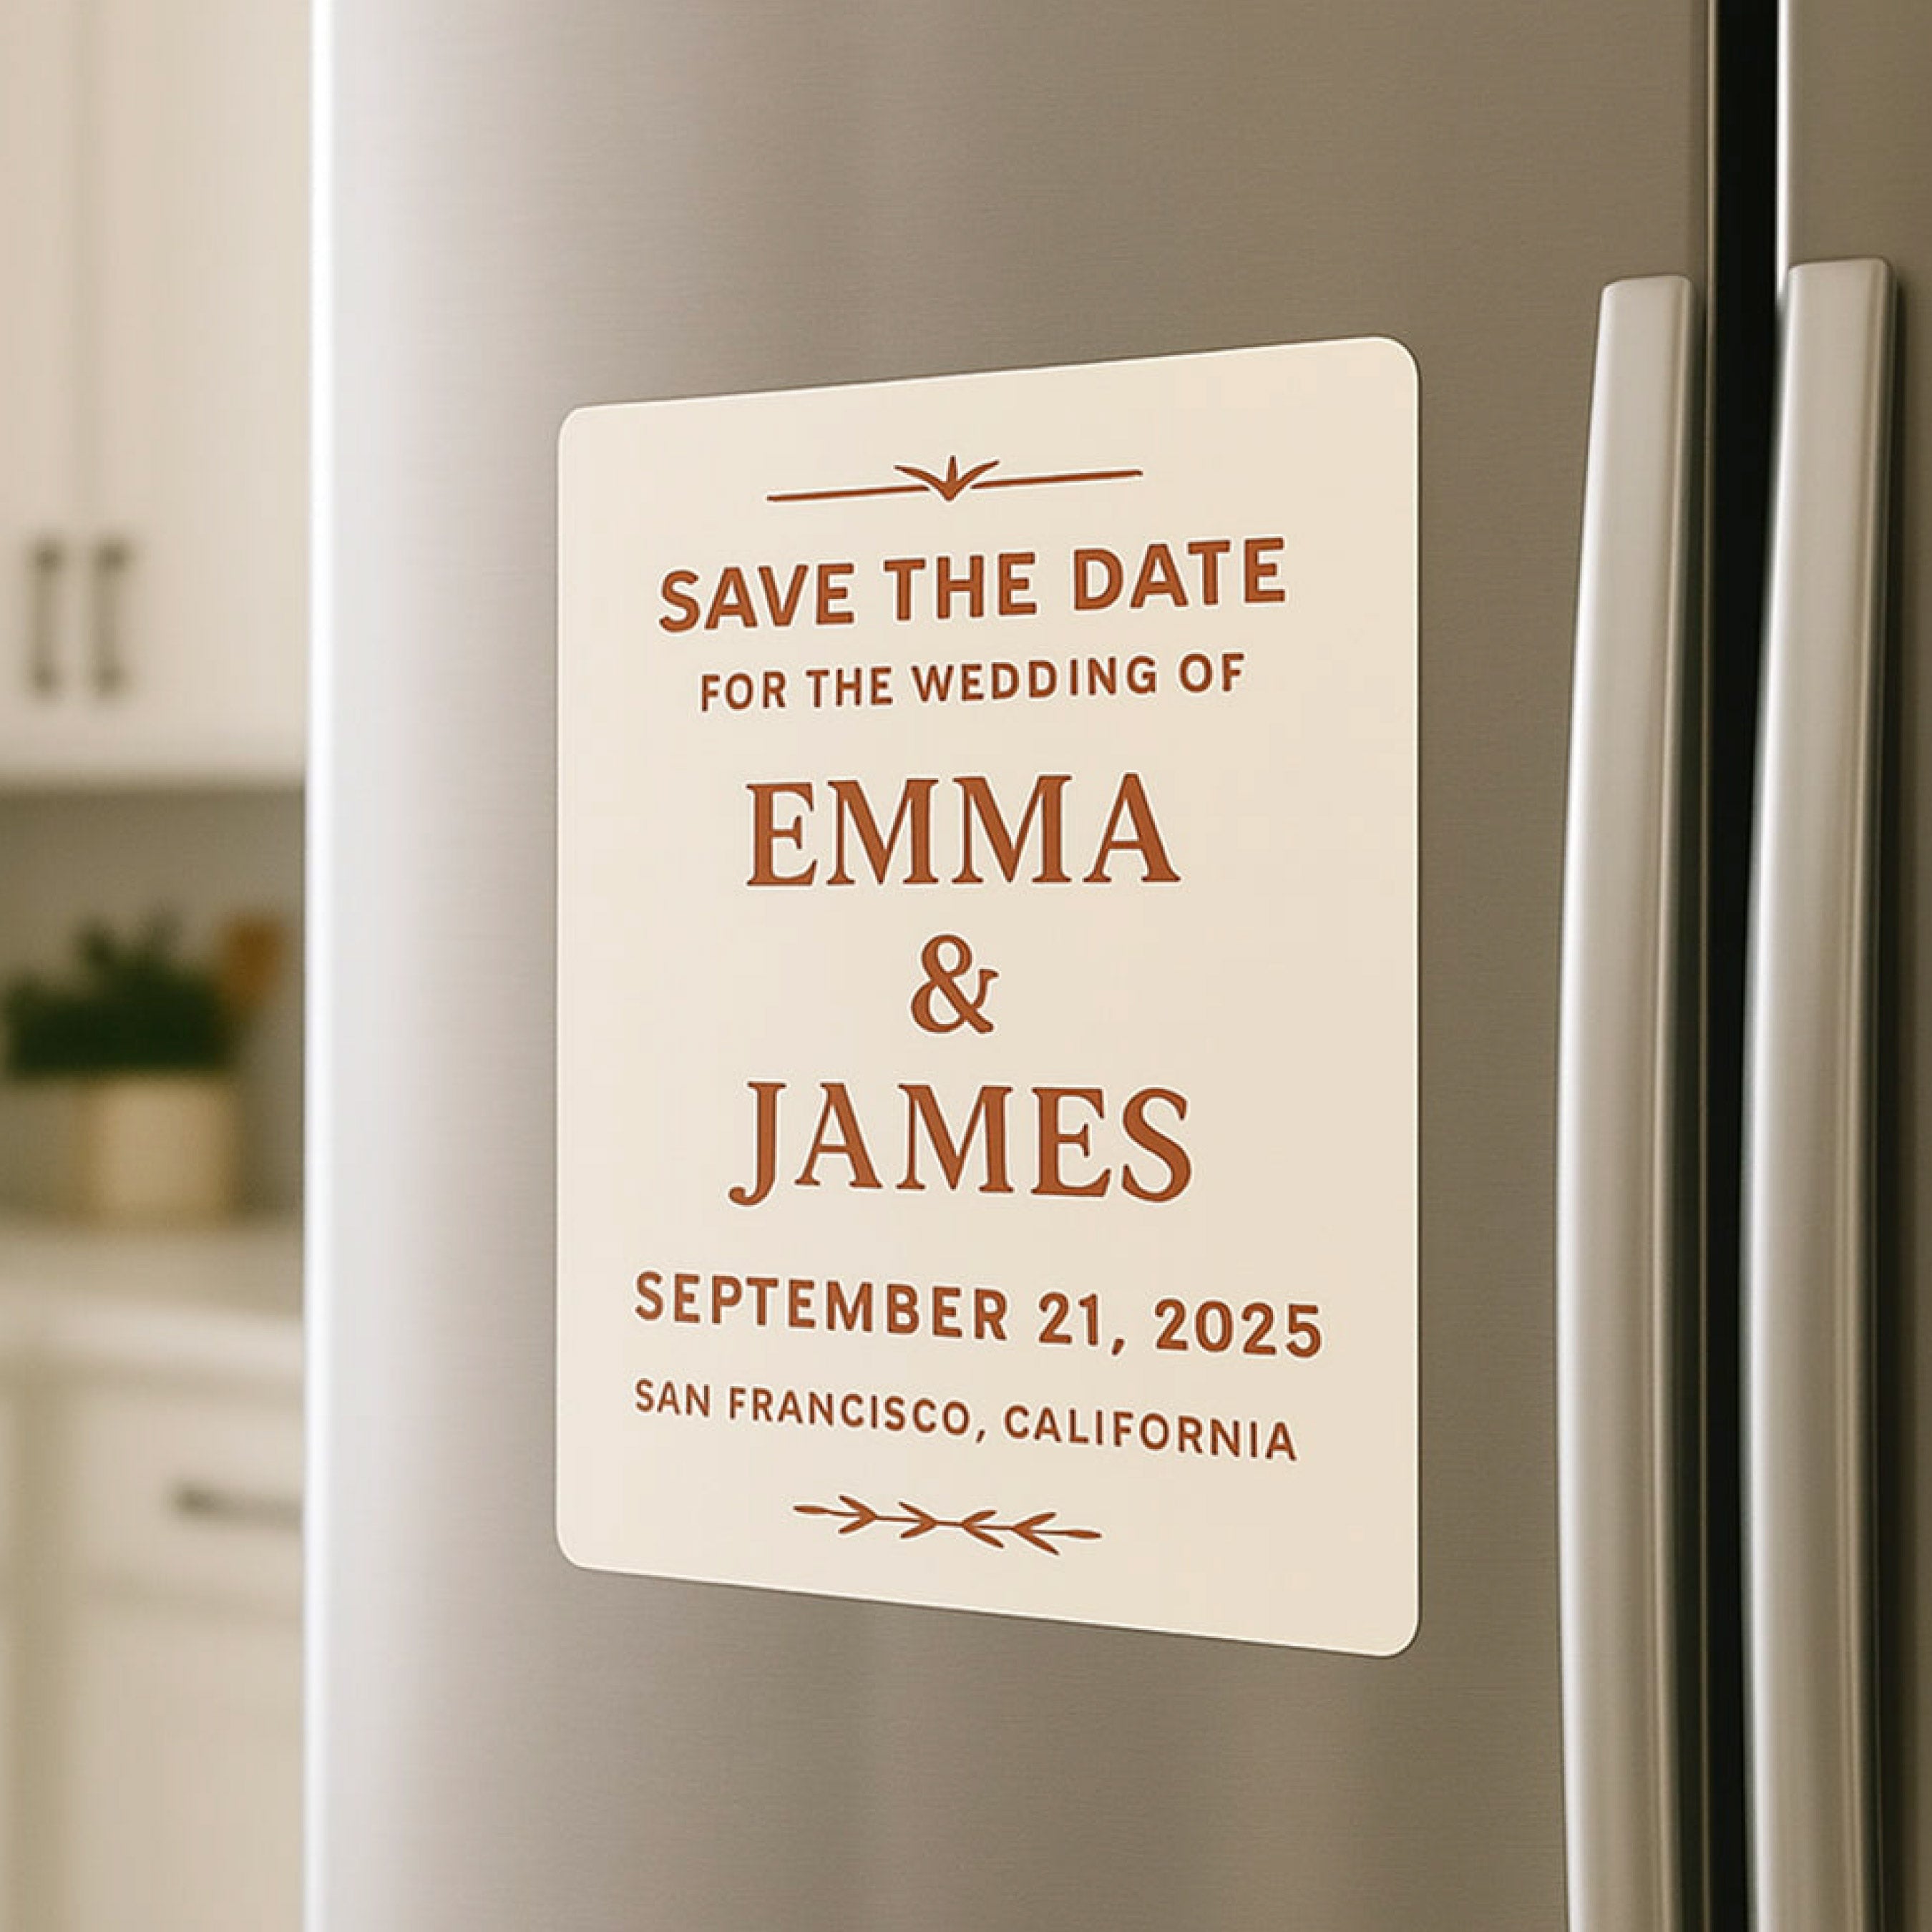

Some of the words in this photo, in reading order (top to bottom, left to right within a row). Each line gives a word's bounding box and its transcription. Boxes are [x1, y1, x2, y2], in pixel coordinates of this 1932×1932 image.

[658, 562, 856, 635] SAVE
[882, 550, 1039, 623] THE
[1073, 536, 1287, 612] DATE
[700, 669, 787, 713] FOR
[805, 665, 894, 709] THE
[910, 654, 1158, 704] WEDDING
[1177, 650, 1246, 694] OF
[747, 771, 1181, 887] EMMA
[909, 933, 1000, 1035] &
[728, 1080, 1193, 1207] JAMES
[635, 1269, 1008, 1341] SEPTEMBER
[1038, 1291, 1126, 1355] 21,
[1153, 1297, 1323, 1360] 2025
[634, 1378, 712, 1417] SAN
[727, 1385, 987, 1446] FRANCISCO,
[1003, 1403, 1298, 1461] CALIFORNIA
